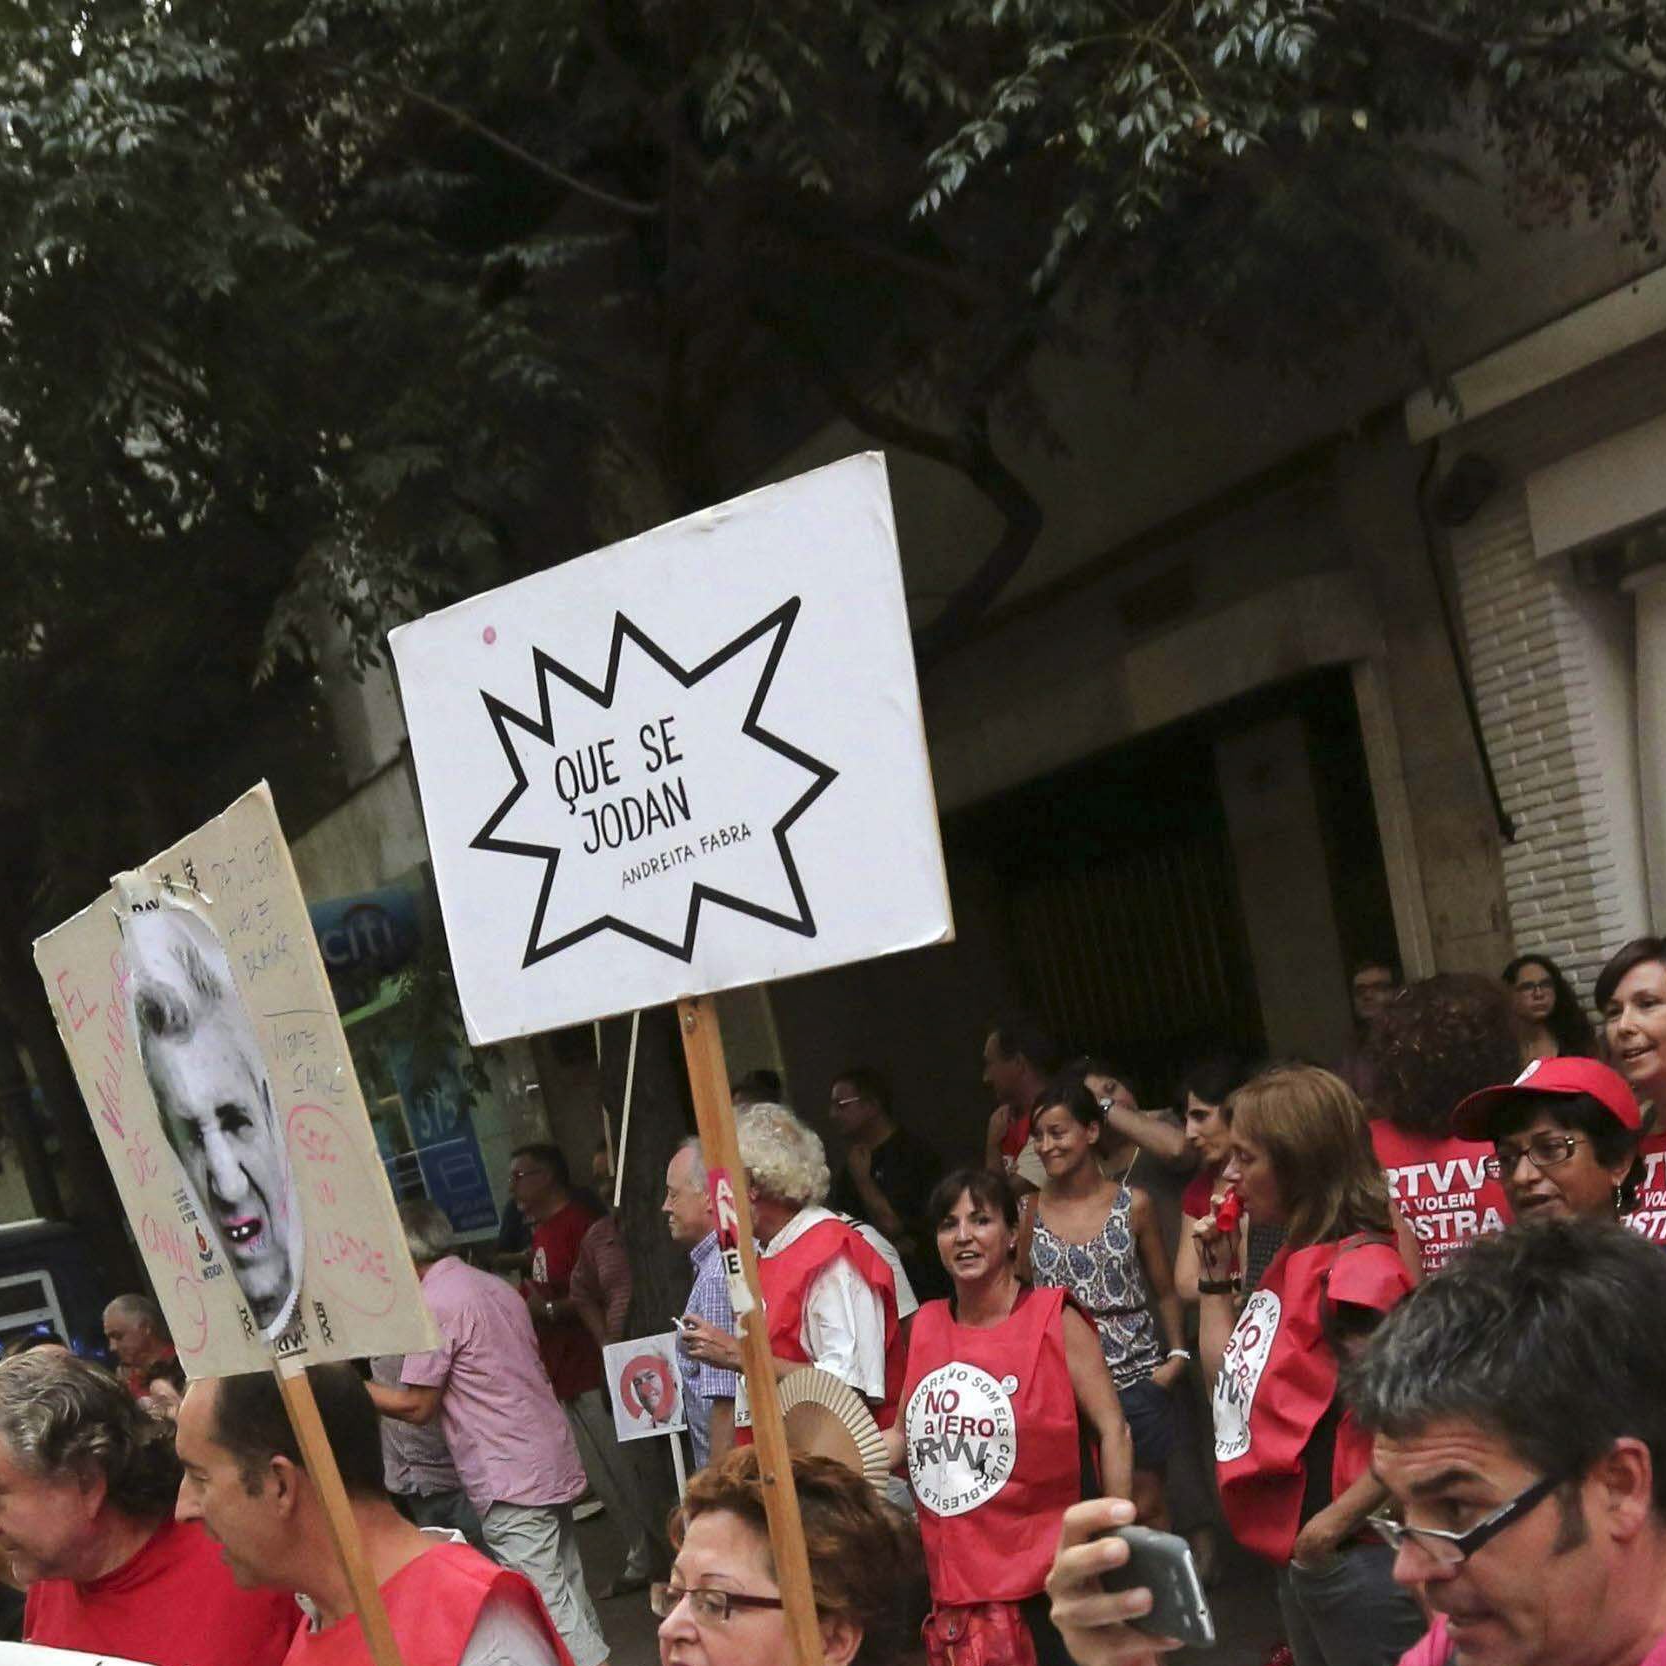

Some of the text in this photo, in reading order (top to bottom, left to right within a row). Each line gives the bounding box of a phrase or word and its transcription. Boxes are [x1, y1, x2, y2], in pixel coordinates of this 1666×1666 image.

[555, 716, 683, 815] QUE SE
[581, 776, 691, 854] JODAN
[622, 822, 752, 889] ANDREITA FABRA
[1414, 1191, 1476, 1211] VOLEM
[925, 1389, 960, 1415] NO
[971, 1376, 1001, 1404] SOM
[994, 1406, 1010, 1438] ELS
